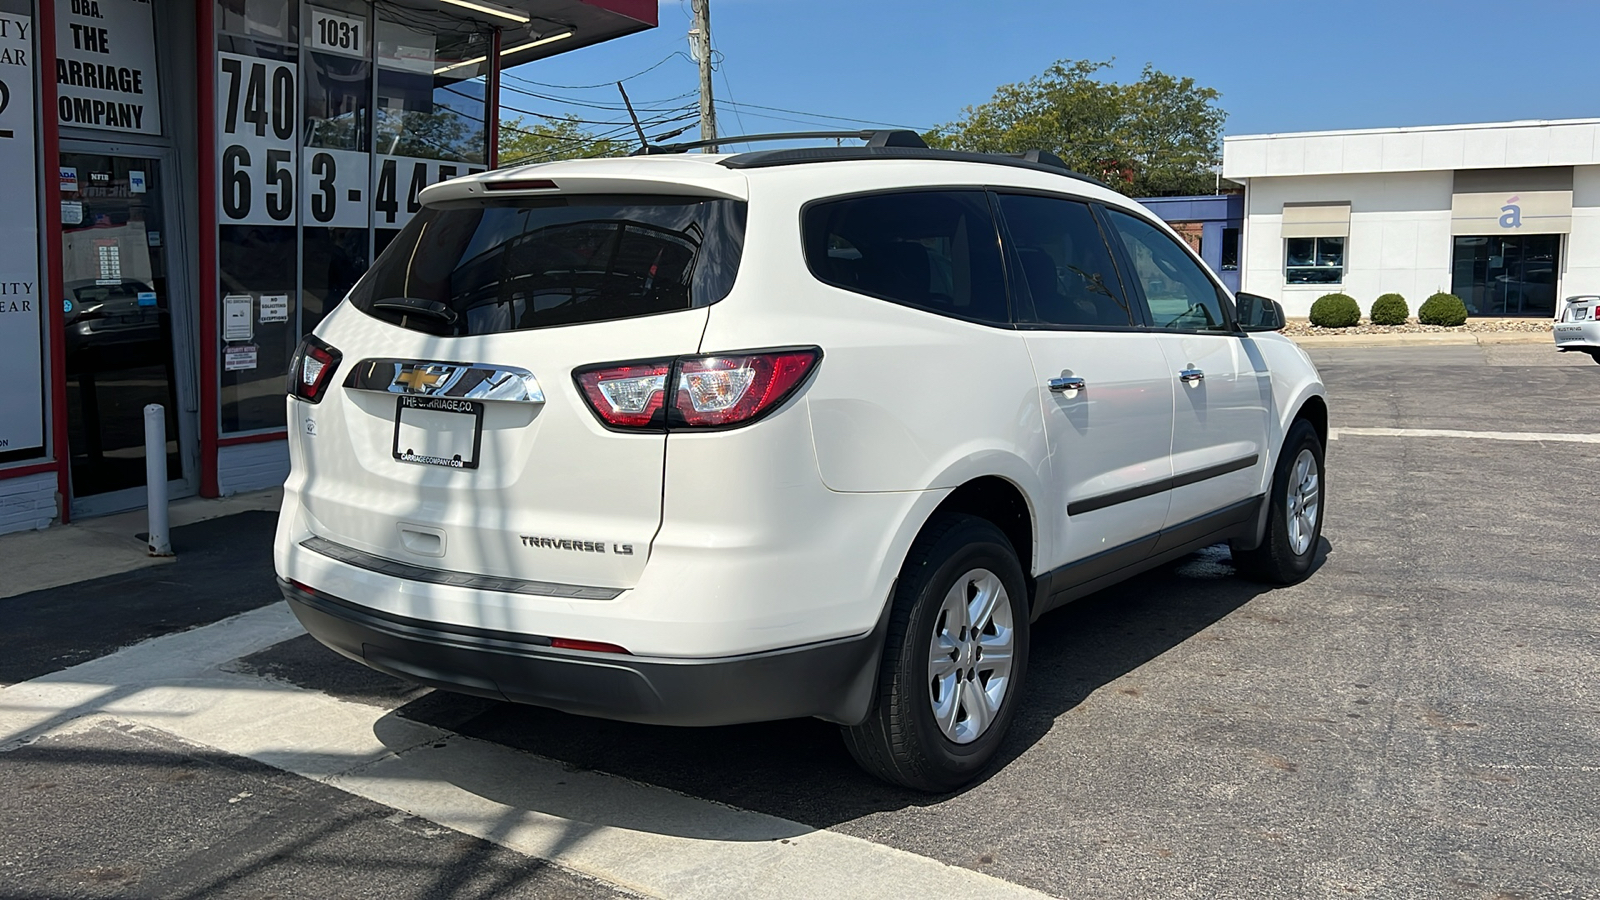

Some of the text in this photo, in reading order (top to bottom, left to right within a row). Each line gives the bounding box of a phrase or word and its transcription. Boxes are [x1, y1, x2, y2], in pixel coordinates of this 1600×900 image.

[70, 23, 110, 54] THE
[317, 18, 359, 51] 1031
[221, 58, 294, 140] 740
[402, 396, 417, 407] THE
[418, 398, 459, 411] CRRIAGE
[520, 534, 634, 555] TRAVERSE LS
